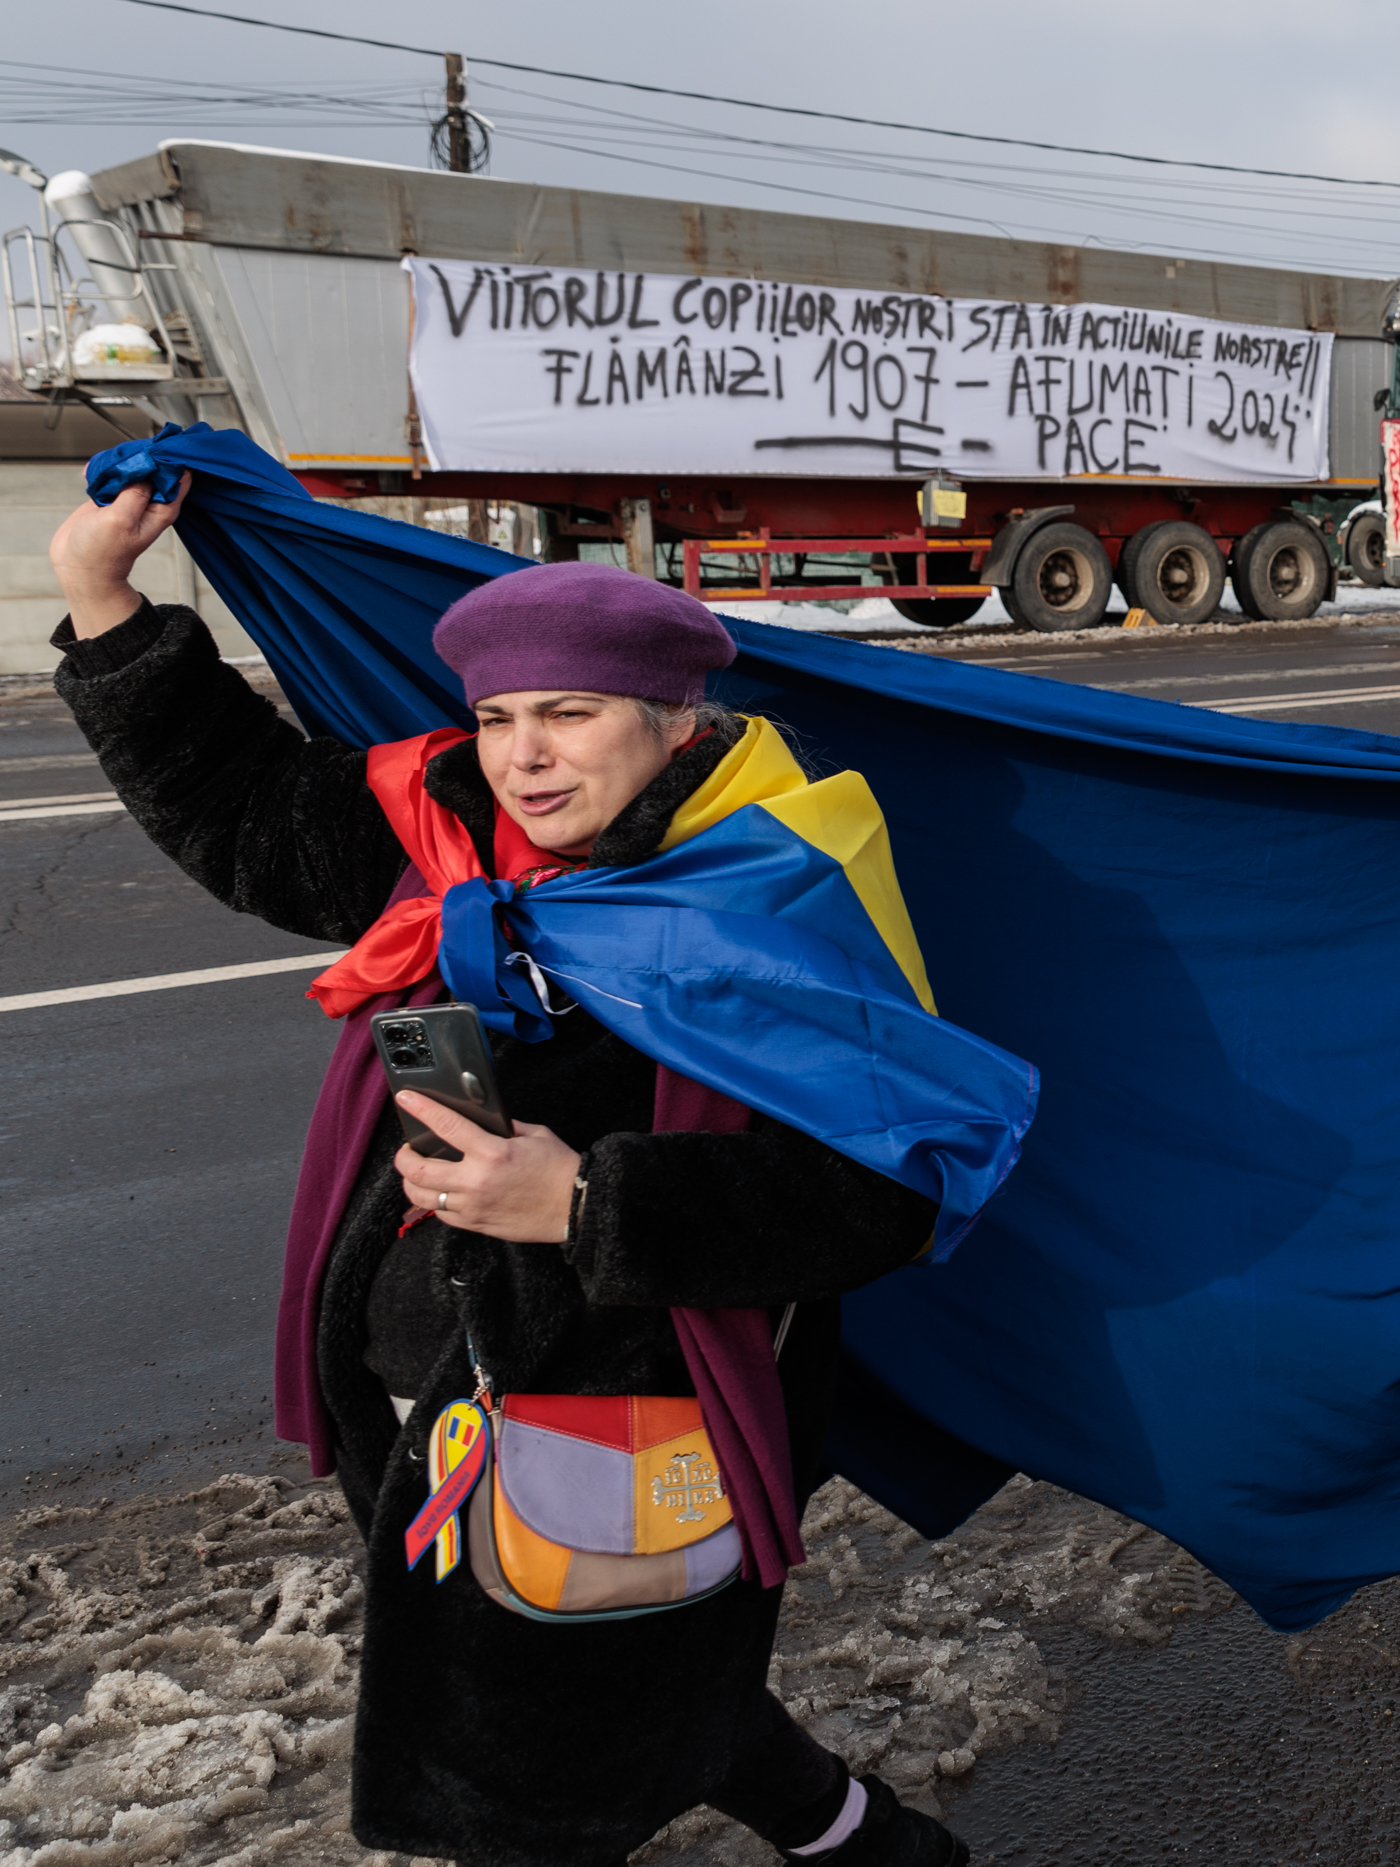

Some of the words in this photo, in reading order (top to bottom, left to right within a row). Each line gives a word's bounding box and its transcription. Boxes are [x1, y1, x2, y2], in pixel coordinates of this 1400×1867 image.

[813, 337, 941, 425] 1907
[1207, 370, 1297, 465] 2024
[1034, 413, 1162, 475] PACE
[415, 1512, 437, 1539] love
[435, 1470, 471, 1516] ROMANIA
